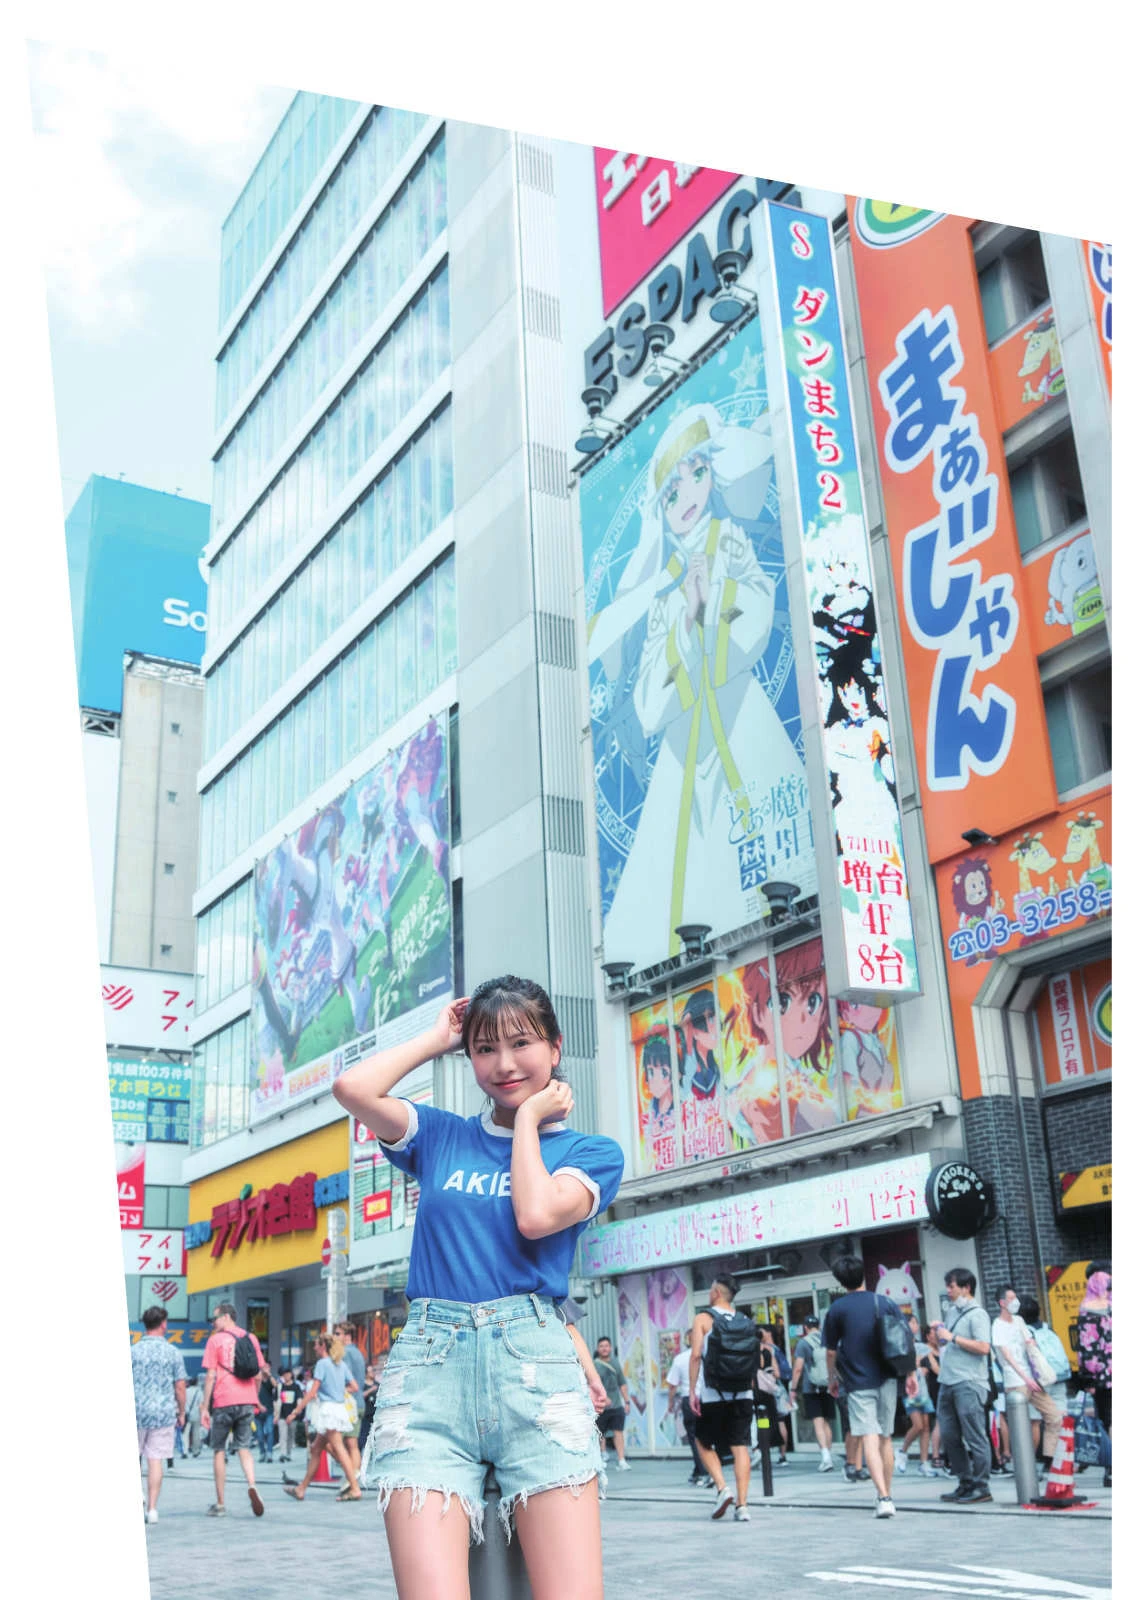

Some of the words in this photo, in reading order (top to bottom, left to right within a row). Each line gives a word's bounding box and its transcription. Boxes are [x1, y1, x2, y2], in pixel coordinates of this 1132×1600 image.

[793, 288, 843, 509] ダンまち2
[884, 316, 1012, 780] まぁじゃん
[843, 859, 904, 896] 増台
[861, 902, 893, 936] 4F
[857, 943, 904, 985] 8台
